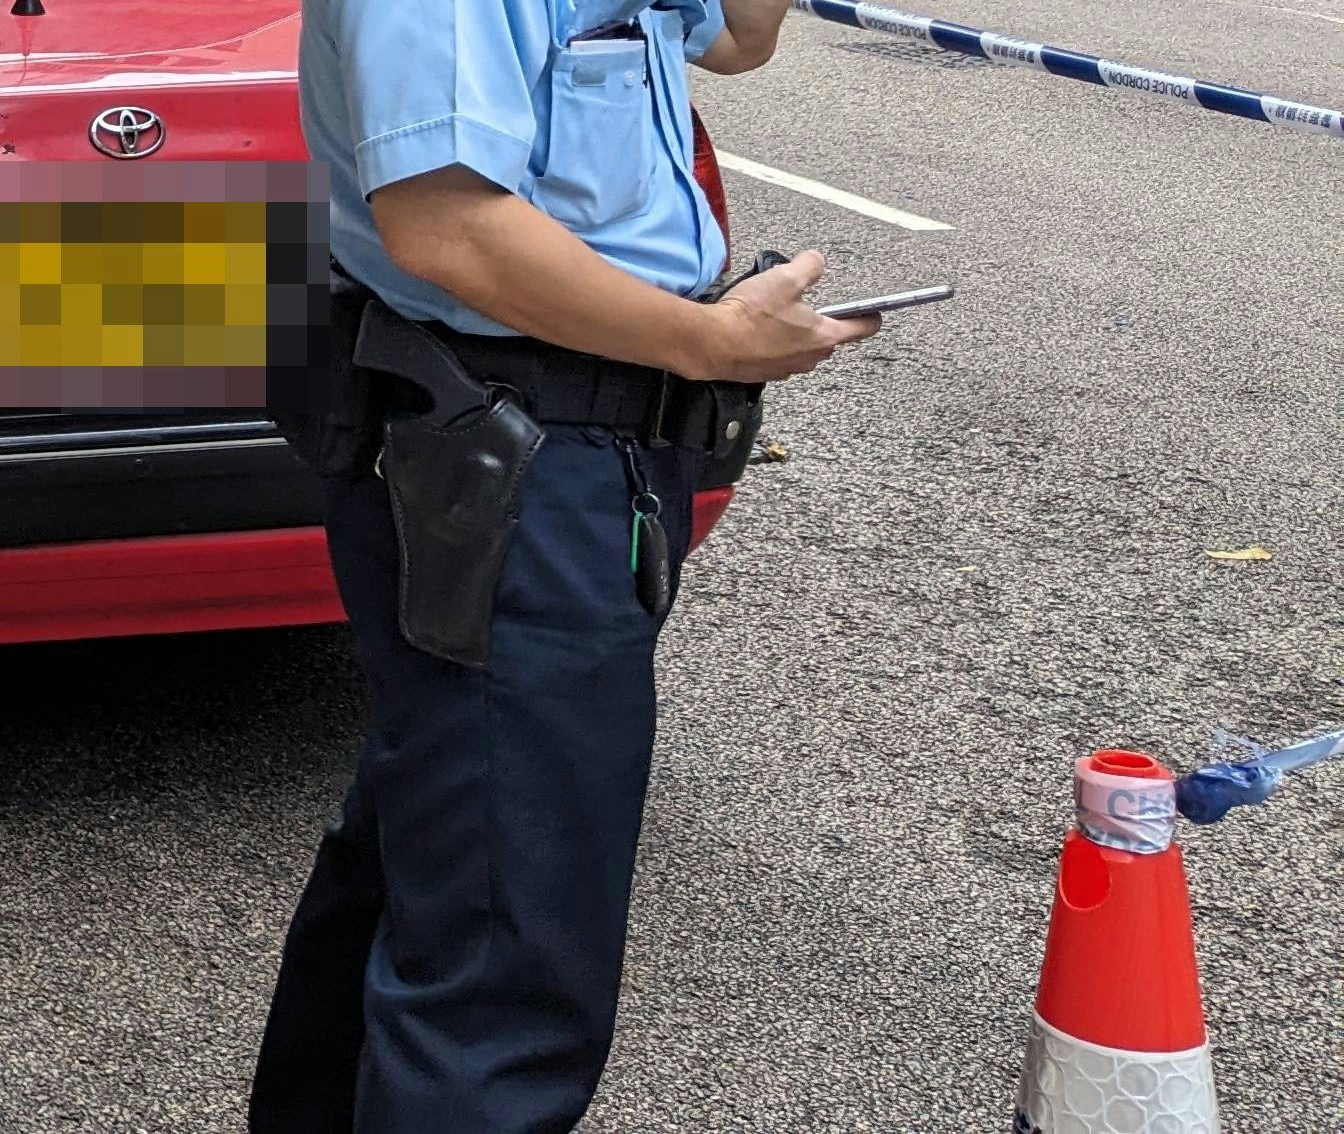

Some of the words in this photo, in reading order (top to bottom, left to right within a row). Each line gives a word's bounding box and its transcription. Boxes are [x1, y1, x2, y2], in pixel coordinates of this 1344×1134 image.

[864, 18, 898, 37] CORDON
[898, 22, 927, 41] POLICE
[1108, 69, 1150, 92] CORDON
[1151, 78, 1190, 101] POLICE
